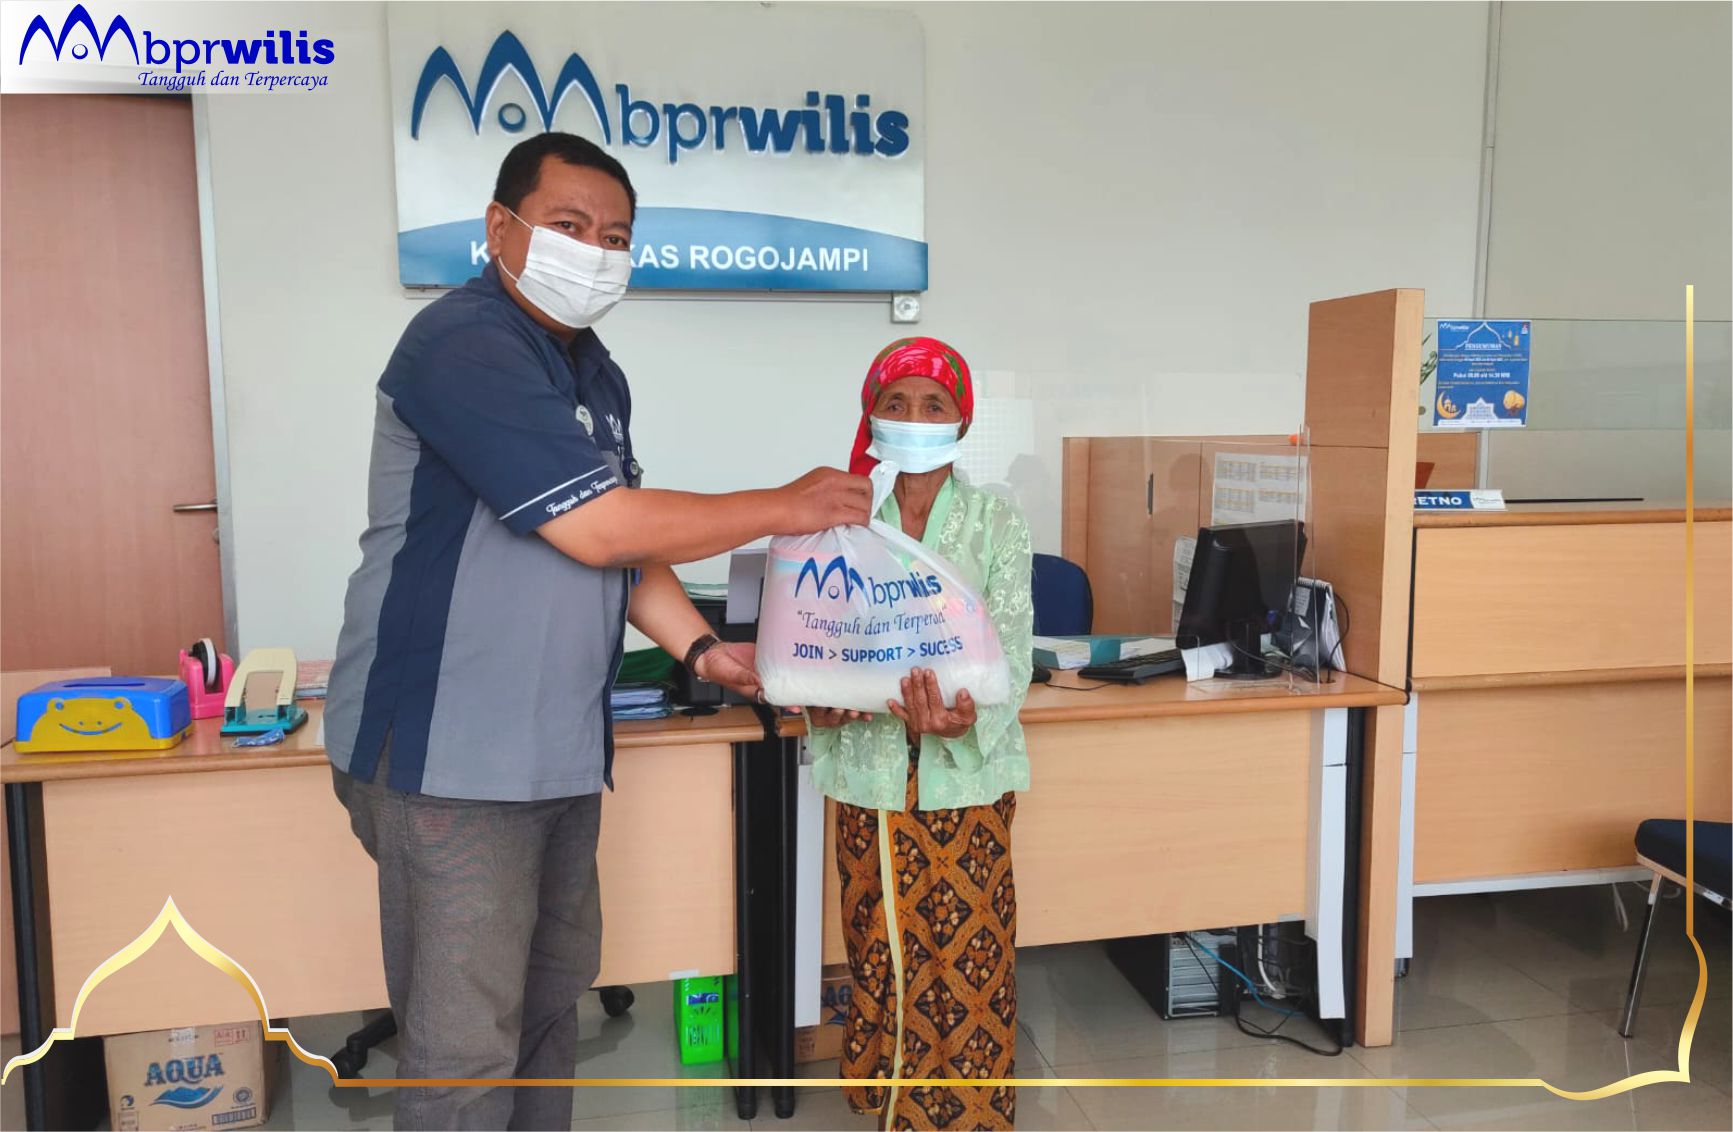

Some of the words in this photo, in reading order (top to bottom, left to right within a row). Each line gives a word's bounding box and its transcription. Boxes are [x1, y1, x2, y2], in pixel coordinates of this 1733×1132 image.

[615, 84, 910, 164] bprwilis
[631, 244, 680, 271] AS
[689, 245, 869, 272] ROGOJAMPI
[864, 615, 890, 635] dan
[792, 643, 824, 660] JOIN
[841, 646, 903, 663] SUPPORT
[821, 983, 853, 1008] AQ
[144, 1052, 226, 1086] AQUA
